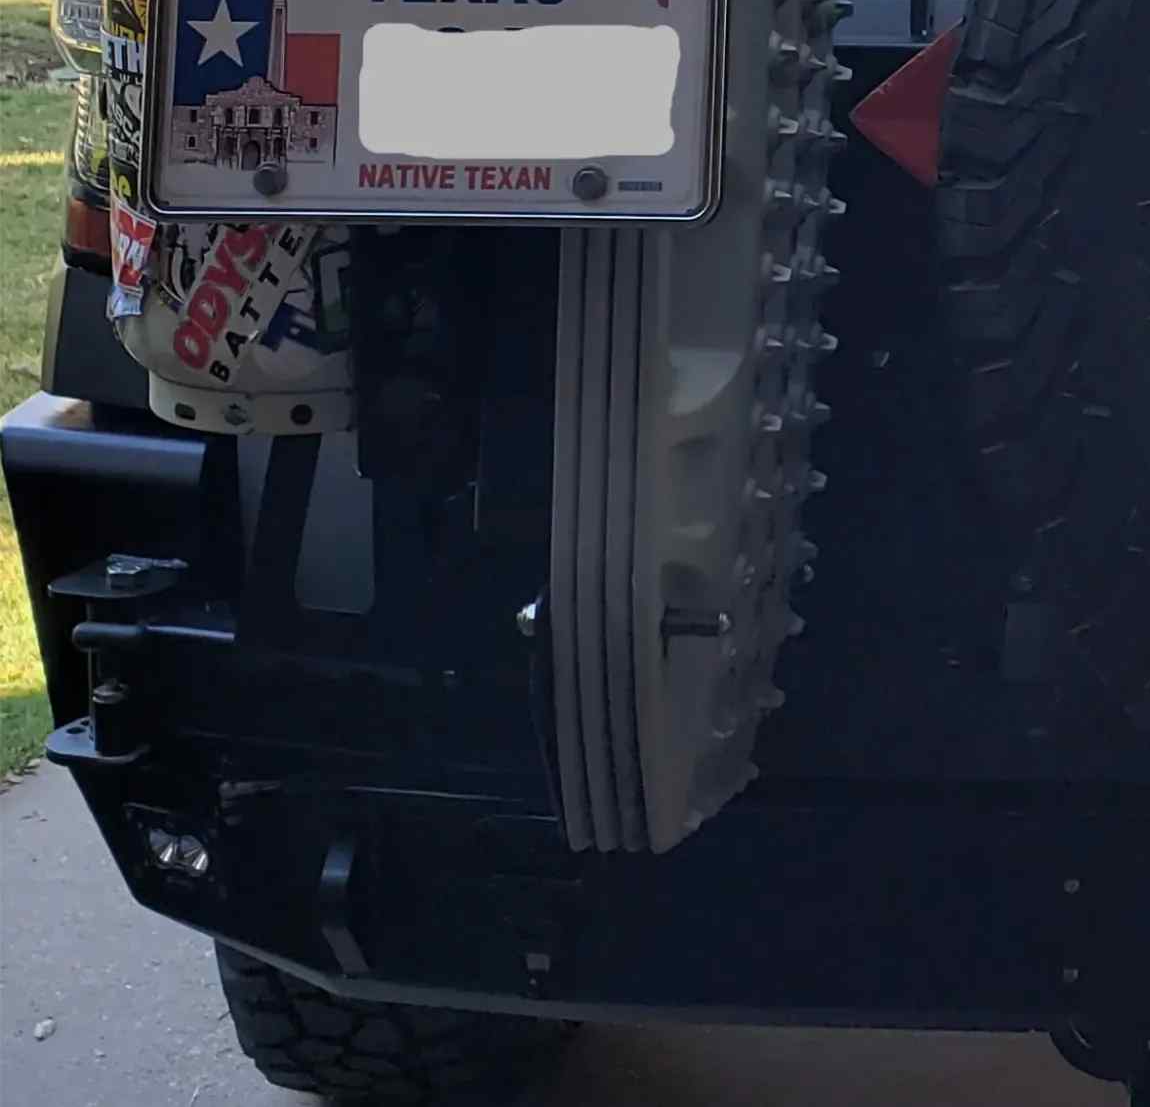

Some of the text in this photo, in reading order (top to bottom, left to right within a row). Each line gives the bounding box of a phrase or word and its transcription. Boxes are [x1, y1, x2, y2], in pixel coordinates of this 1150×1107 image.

[358, 163, 553, 190] NATIVE TEXAN
[173, 225, 278, 370] ODYS
